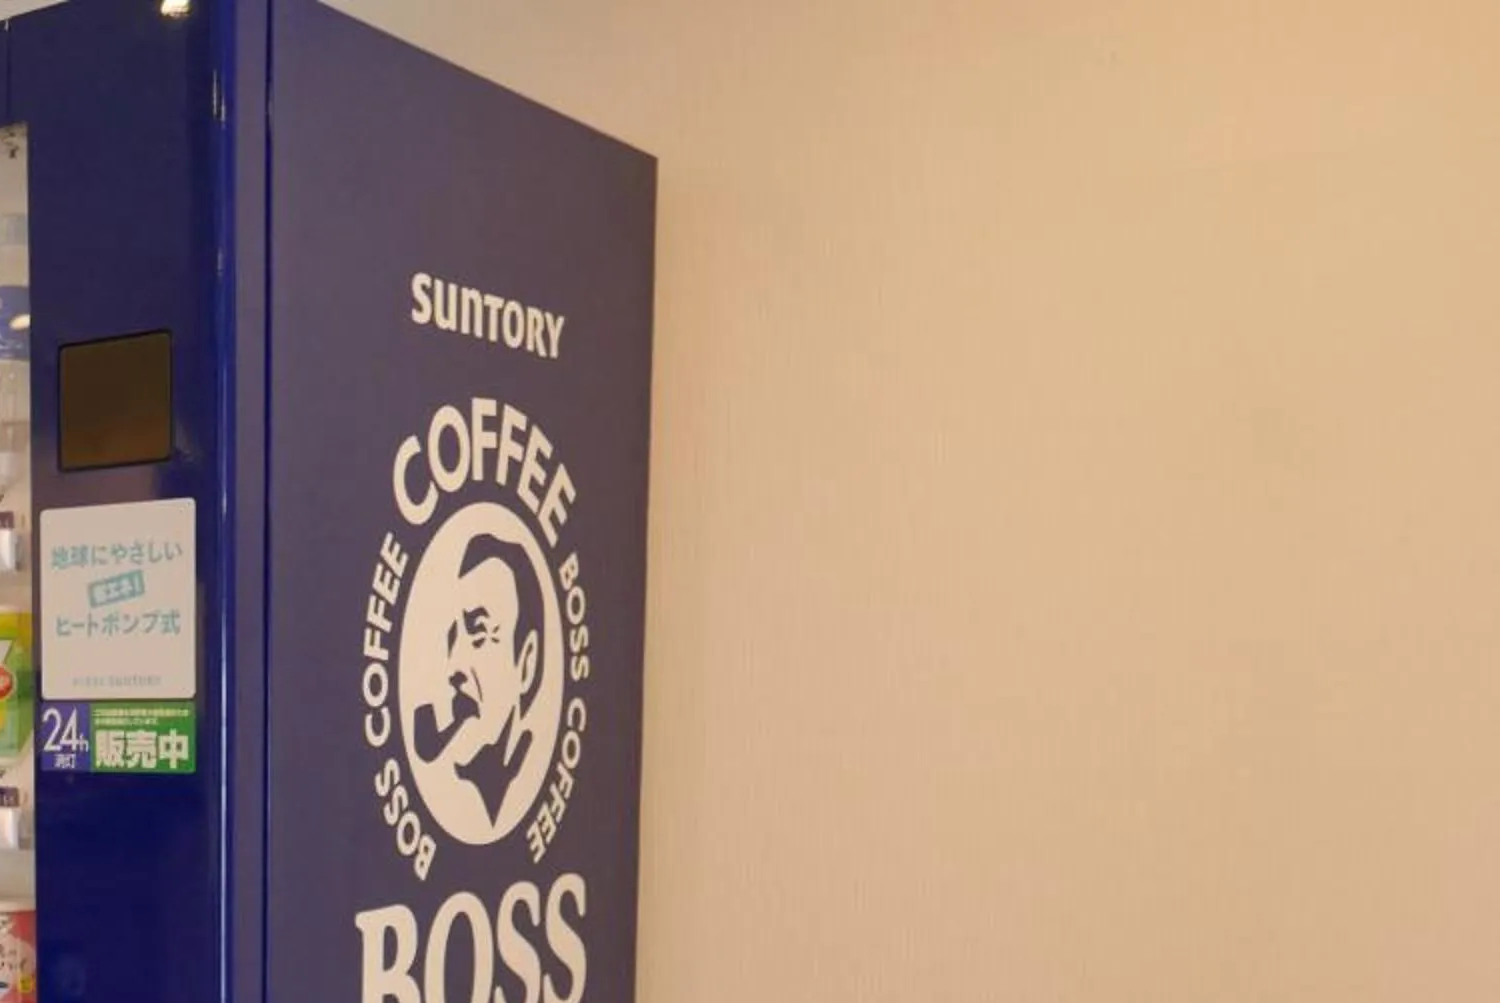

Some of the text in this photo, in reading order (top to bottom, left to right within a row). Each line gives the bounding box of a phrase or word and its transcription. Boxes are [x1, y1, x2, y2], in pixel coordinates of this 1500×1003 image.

[411, 272, 565, 359] SUNTORY
[393, 397, 576, 548] COFFEE
[51, 541, 183, 568] 地球にやさしい
[55, 610, 182, 637] ヒートポンプ式
[95, 728, 189, 769] 販売中
[362, 532, 437, 880] BOSS COFFEE
[527, 553, 590, 864] BOSS COFFEE
